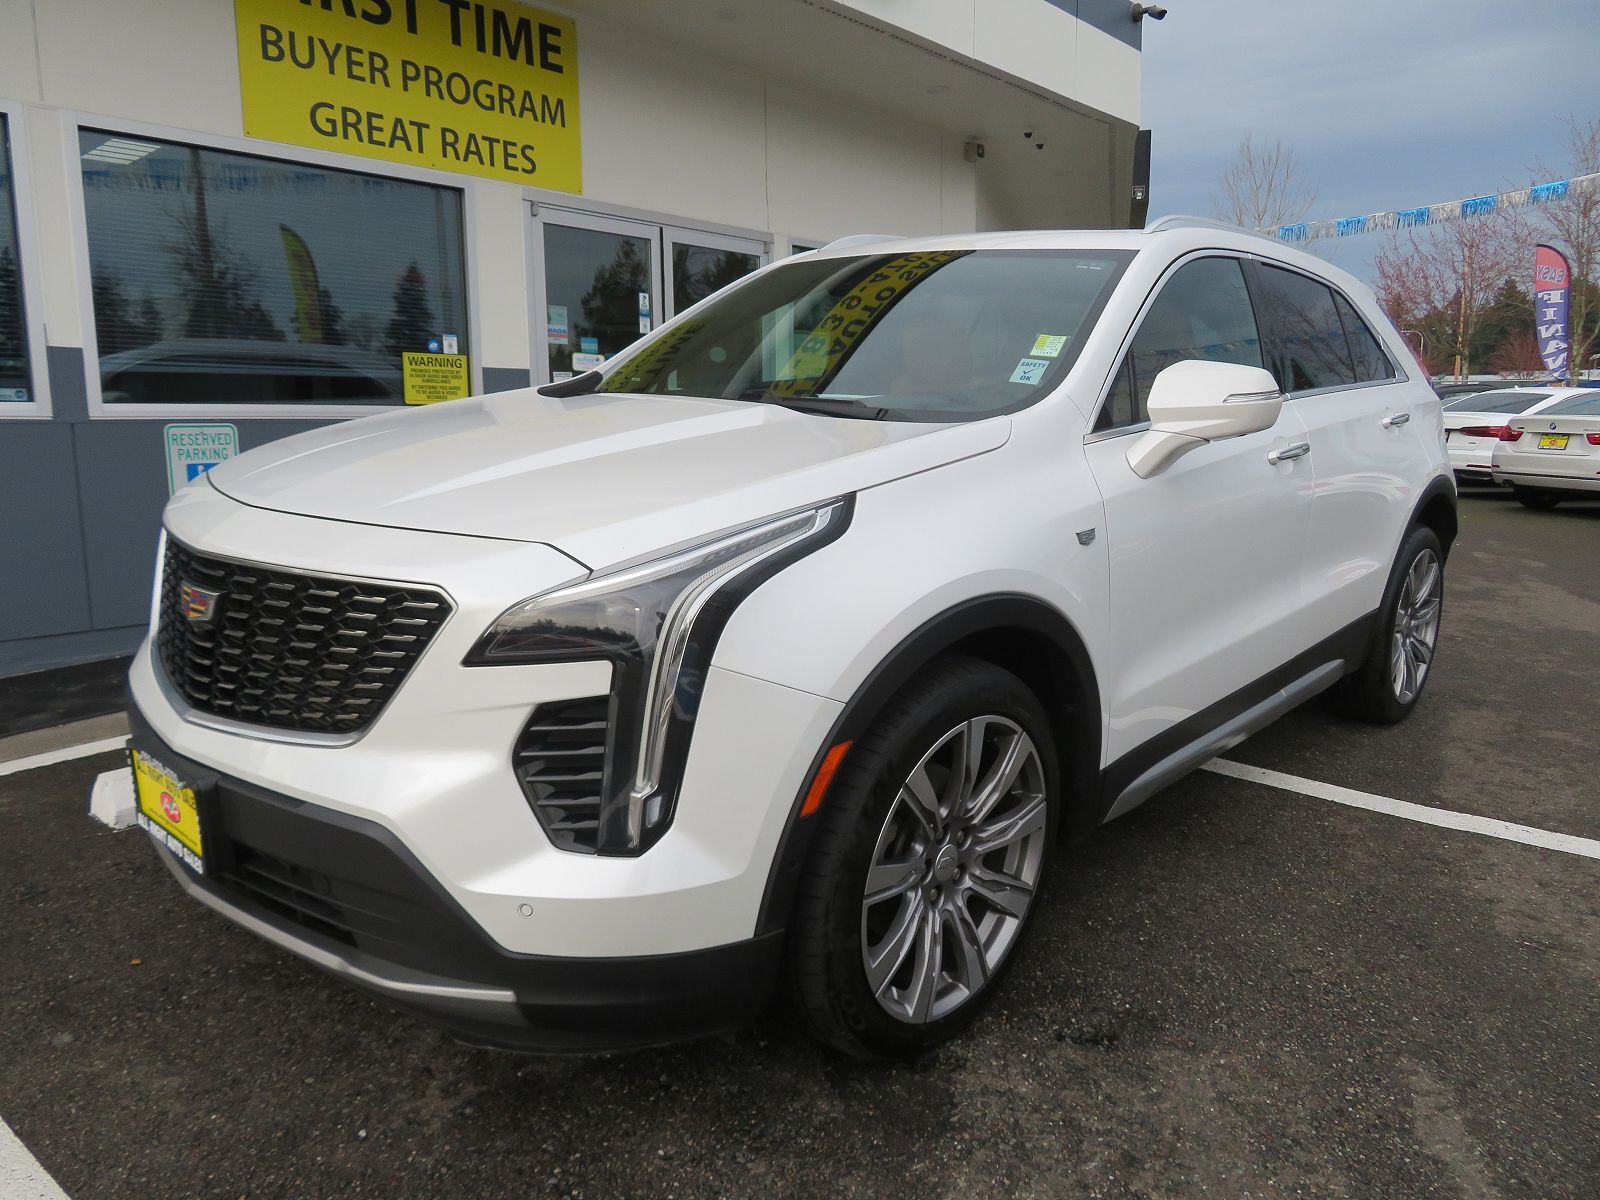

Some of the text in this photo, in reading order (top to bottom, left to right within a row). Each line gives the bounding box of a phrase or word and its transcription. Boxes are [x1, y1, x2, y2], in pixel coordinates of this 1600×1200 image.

[439, 0, 563, 74] TIME
[259, 23, 566, 128] BUYER PROGRAM
[309, 101, 537, 175] GREAT RATES
[407, 356, 463, 369] WARNING
[170, 432, 232, 447] RESERVED
[177, 447, 229, 461] PARKING
